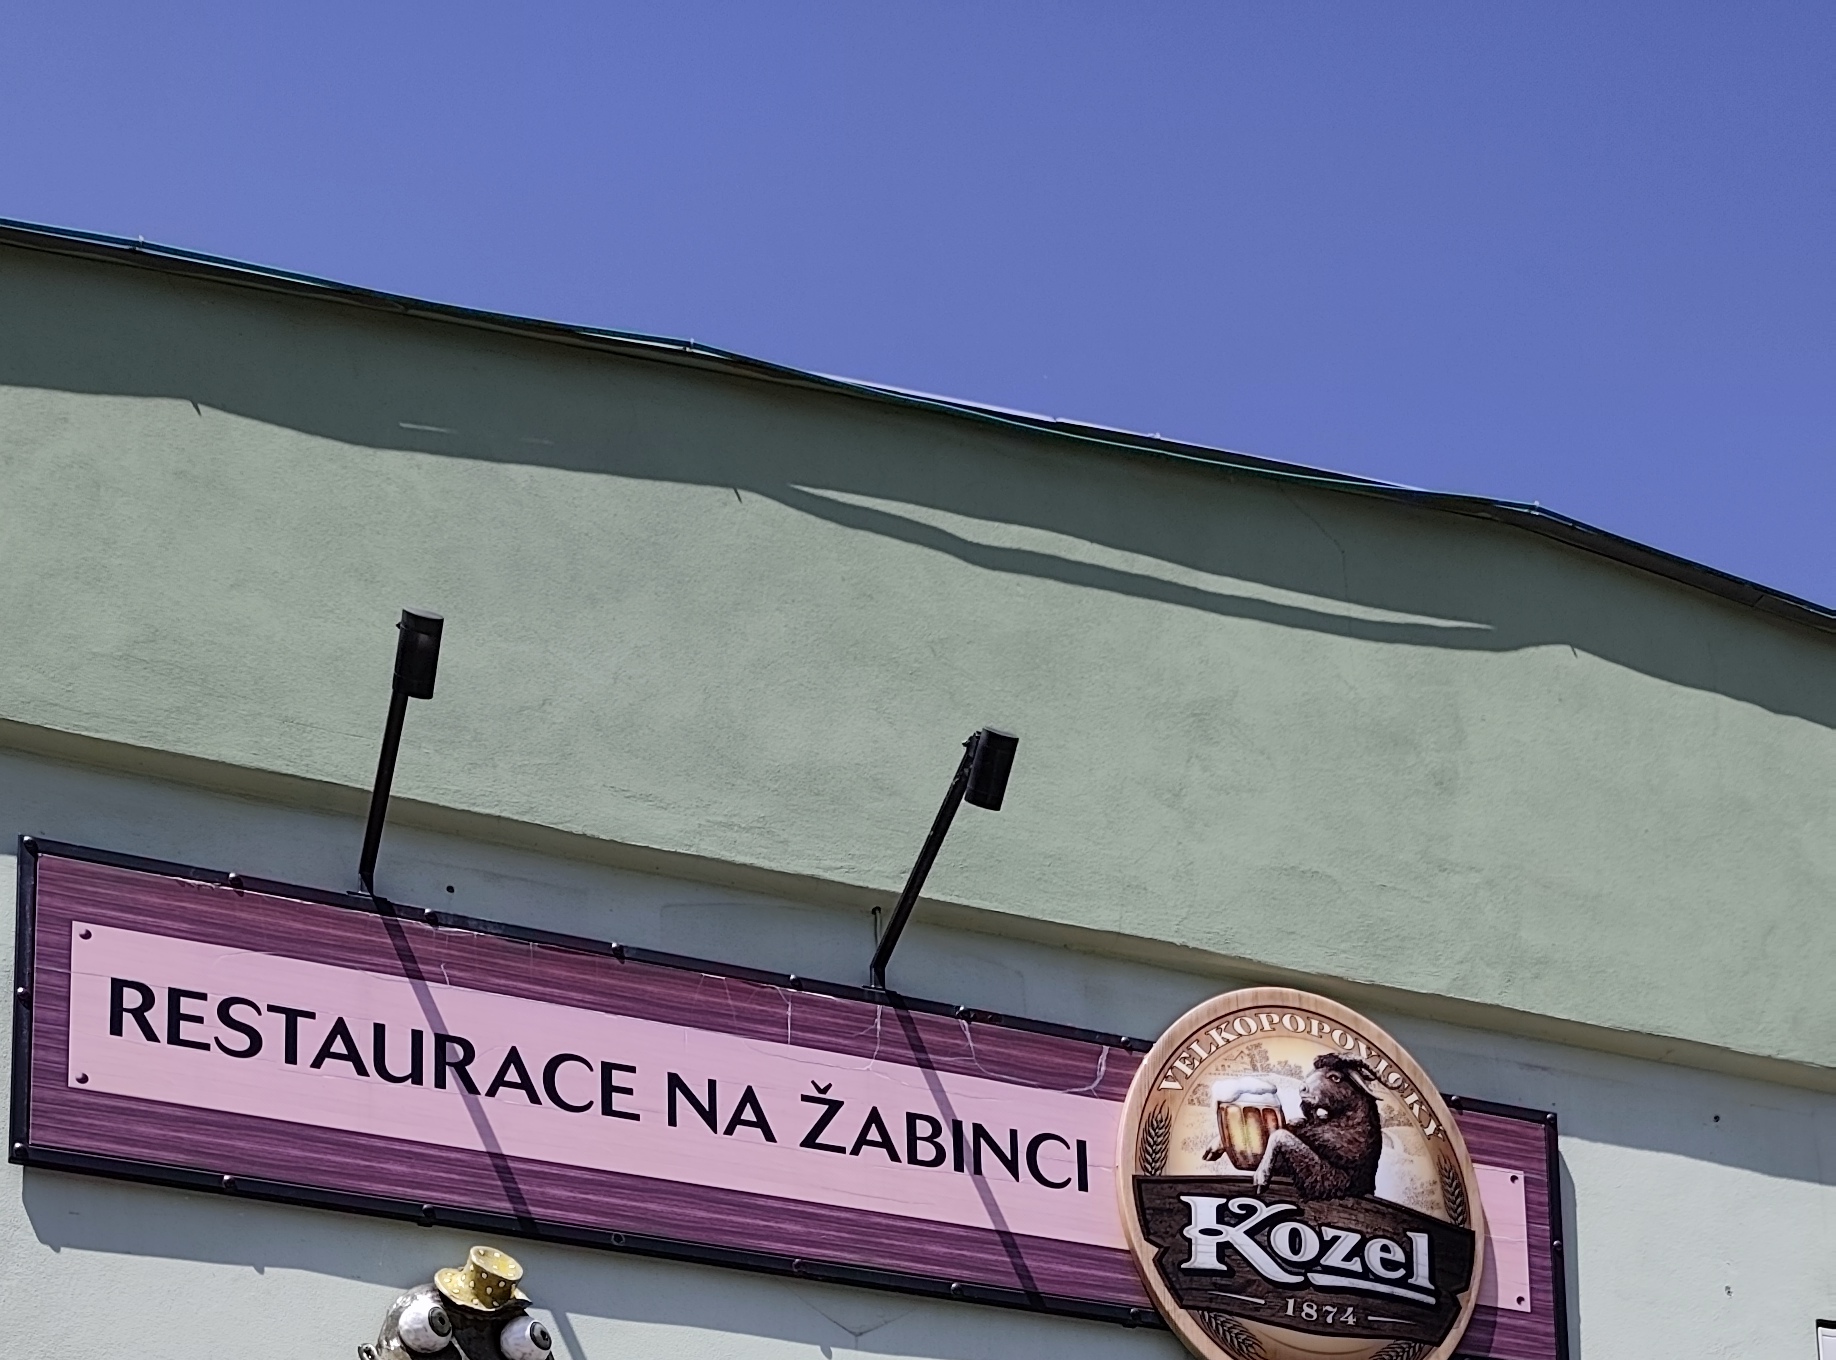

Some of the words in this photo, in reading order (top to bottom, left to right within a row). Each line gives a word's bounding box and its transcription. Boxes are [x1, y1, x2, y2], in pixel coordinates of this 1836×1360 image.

[109, 977, 641, 1121] RESTAURACE
[667, 1071, 777, 1143] NA
[799, 1079, 1089, 1193] ŽABINCI
[1180, 1195, 1436, 1292] Kozel
[1285, 1297, 1358, 1326] 1874
